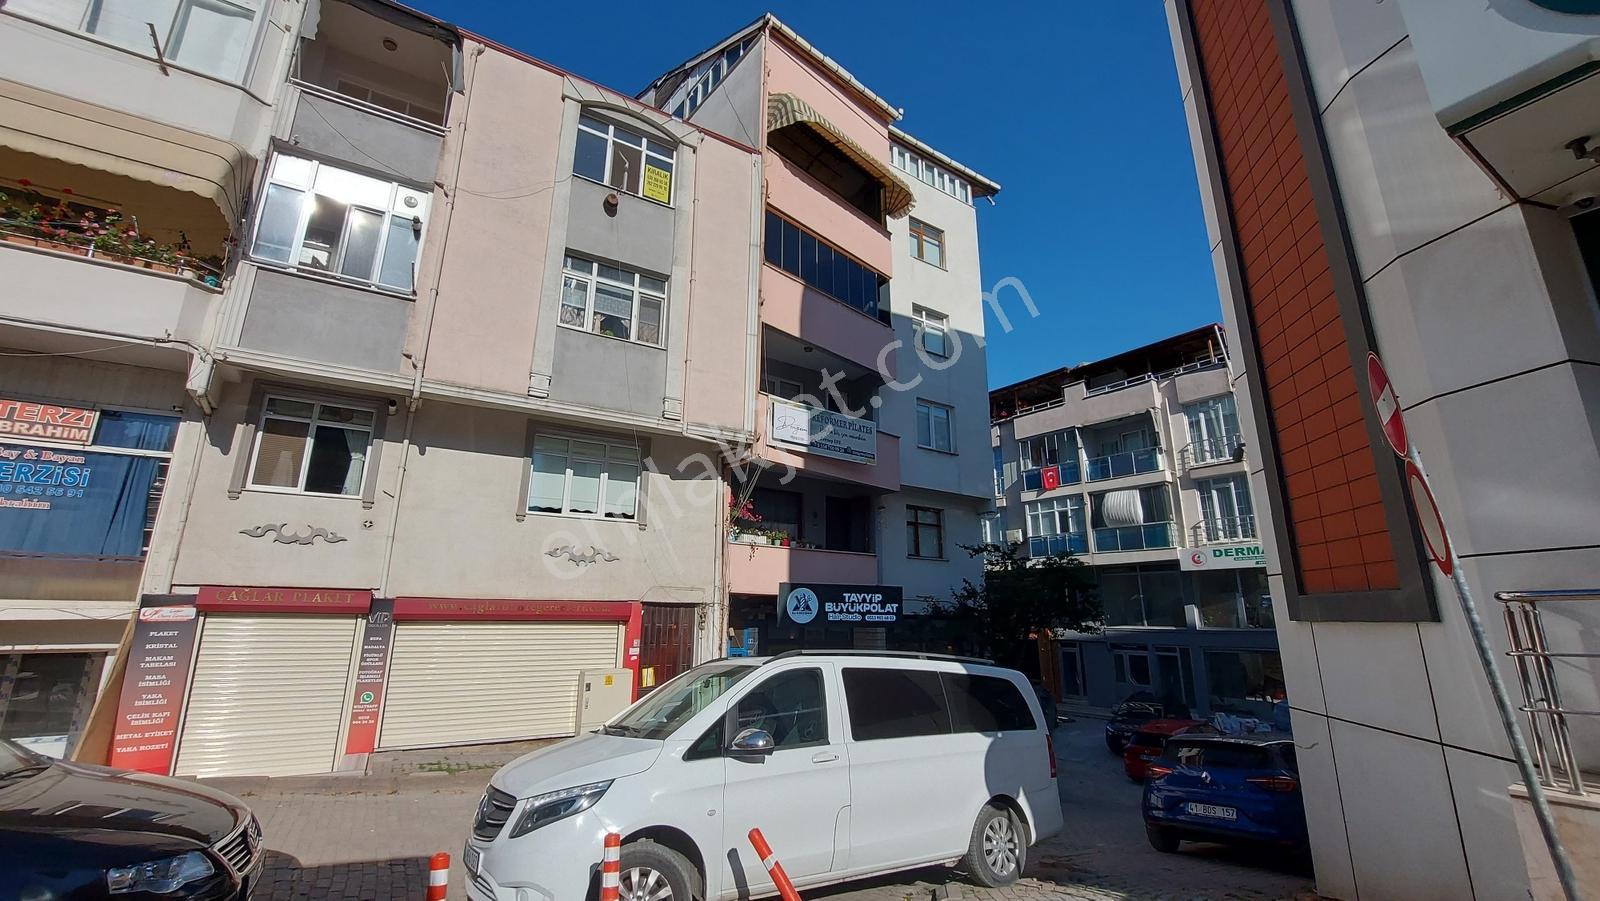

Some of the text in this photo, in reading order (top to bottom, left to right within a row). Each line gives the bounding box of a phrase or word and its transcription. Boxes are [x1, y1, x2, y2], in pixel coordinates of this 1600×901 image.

[647, 167, 668, 178] KIRALIK
[24, 449, 38, 459] &
[41, 450, 85, 464] Bayan
[1212, 546, 1265, 558] DERM
[216, 588, 355, 604] ÇAĞLAR PLAKET
[115, 730, 173, 740] METAL ETİKET
[1190, 803, 1198, 812] 41
[1221, 807, 1235, 817] 157
